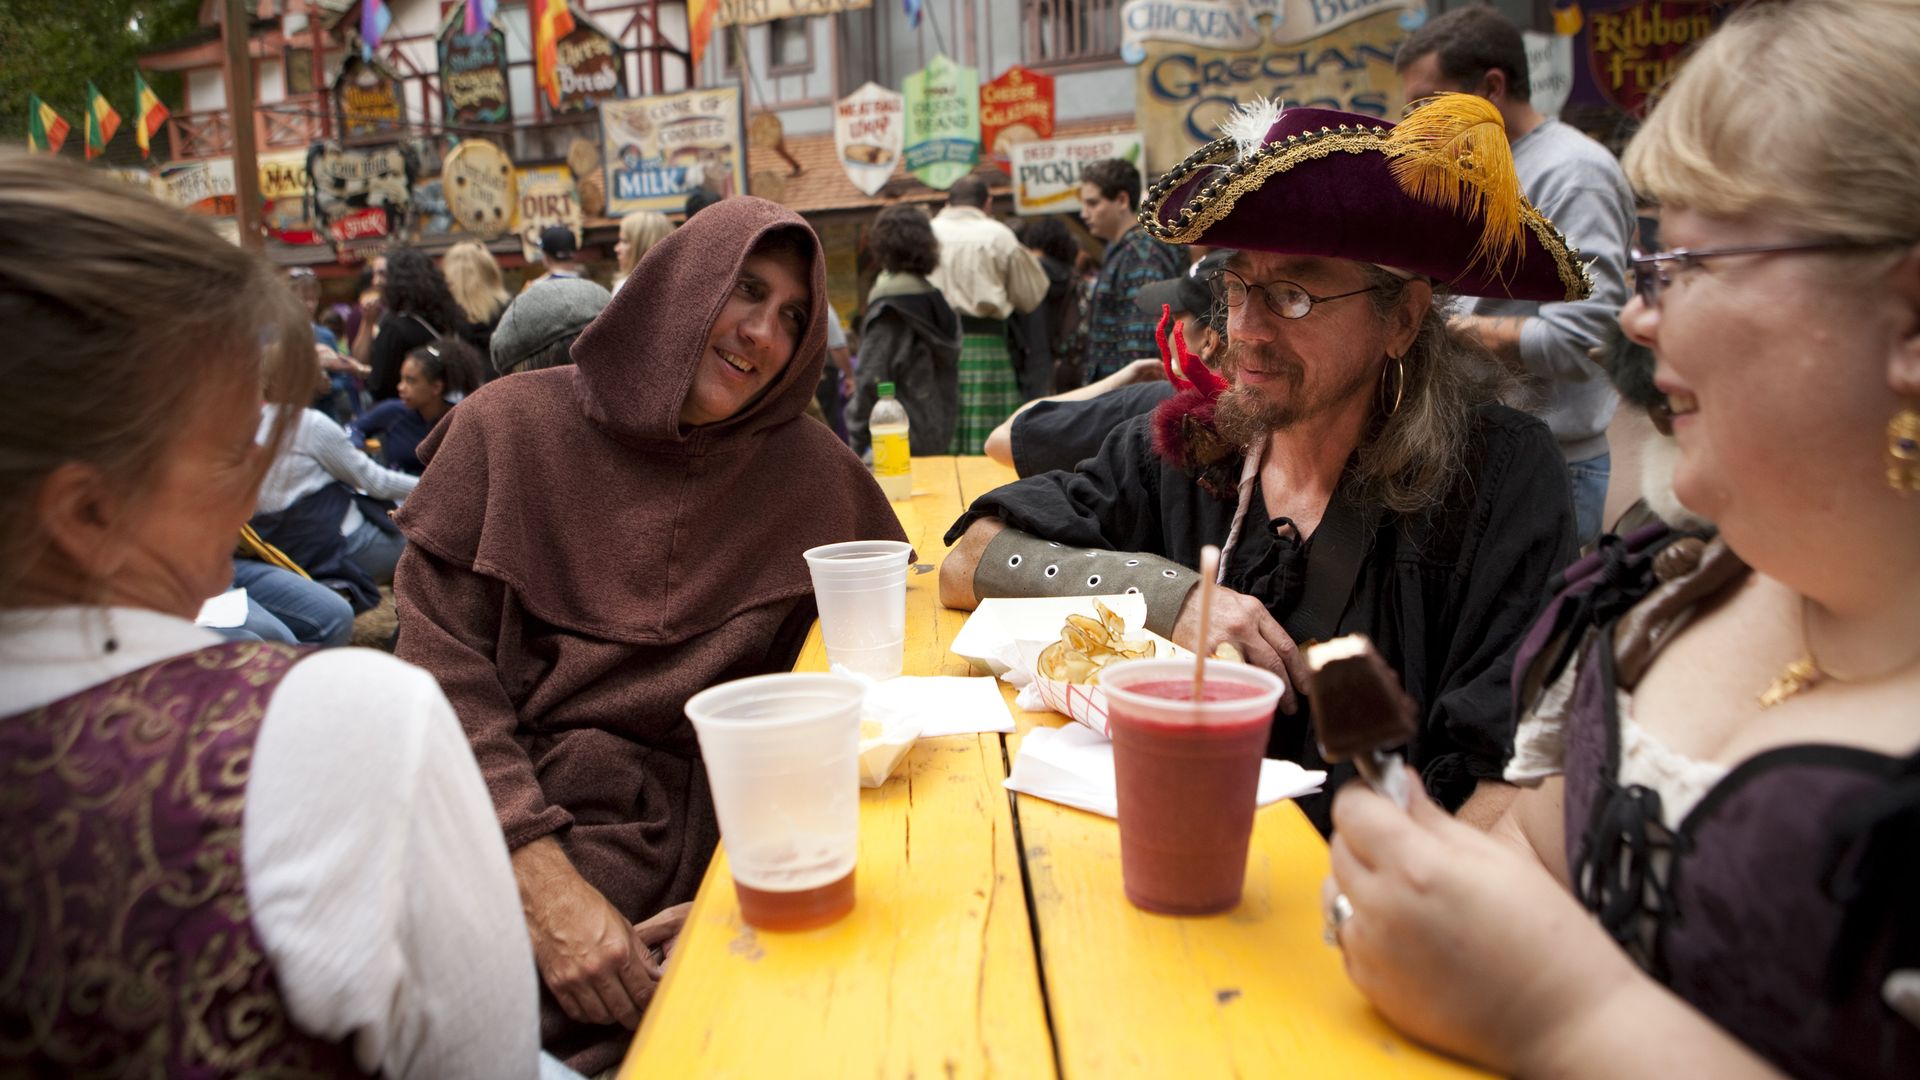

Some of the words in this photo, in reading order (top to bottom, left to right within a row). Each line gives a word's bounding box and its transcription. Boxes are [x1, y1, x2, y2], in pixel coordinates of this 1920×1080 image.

[1127, 4, 1243, 39] CHICKEN
[1592, 3, 1712, 51] Ribbon
[557, 64, 617, 94] Bread
[1150, 43, 1400, 101] GRECIAN
[619, 168, 682, 198] MILK
[1019, 159, 1085, 185] PICKL
[522, 193, 571, 219] DIRT
